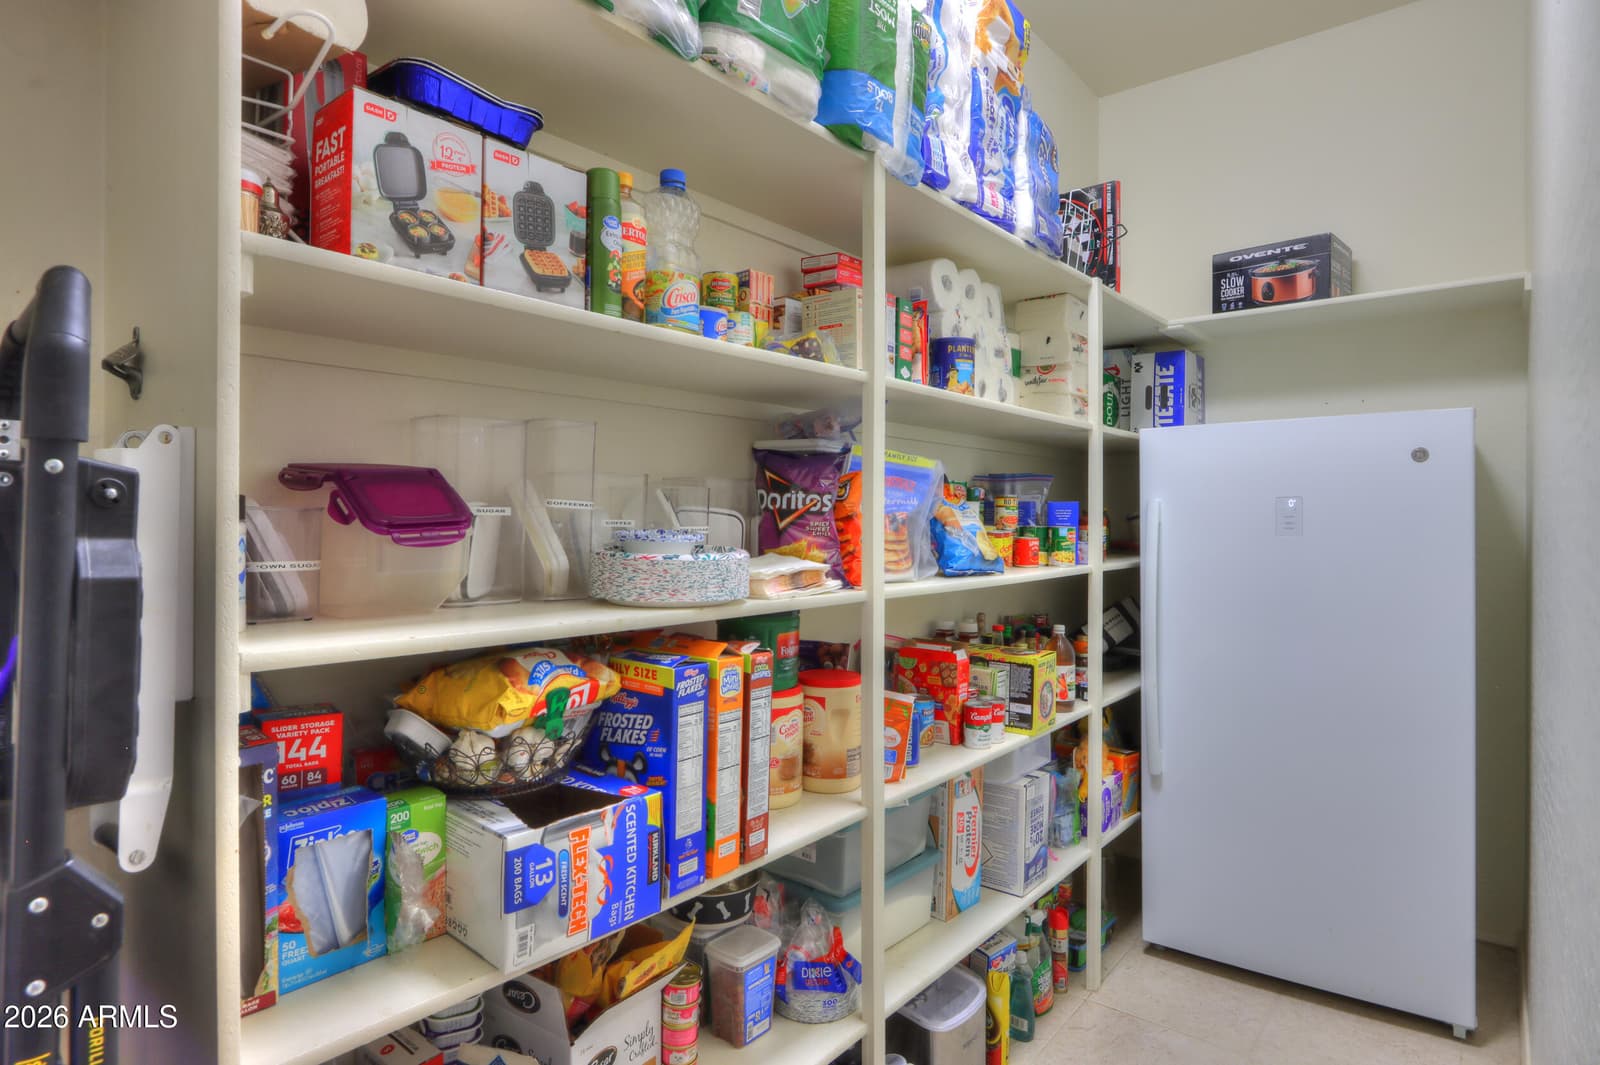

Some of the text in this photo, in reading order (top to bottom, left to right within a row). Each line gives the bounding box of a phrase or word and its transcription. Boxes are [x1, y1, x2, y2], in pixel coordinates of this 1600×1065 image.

[315, 125, 347, 163] FAST
[315, 151, 345, 177] PORTABLE
[441, 162, 467, 173] PROTEIN
[1229, 243, 1309, 263] OVENTE
[1220, 276, 1245, 290] SLOW
[1220, 286, 1245, 298] COOKER
[668, 287, 697, 308] Crisco
[1121, 378, 1131, 417] LIGHT
[757, 489, 834, 513] Doritos
[533, 661, 551, 679] SIZE
[633, 666, 658, 681] SIZE
[676, 674, 705, 691] FROSTED
[678, 682, 703, 698] FLAKES
[271, 720, 335, 733] SLIDER STORAGE
[598, 712, 653, 729] FROSTED
[276, 727, 331, 739] VARIETY PACK
[600, 728, 648, 745] FLAKES
[277, 735, 327, 764] 144
[281, 770, 322, 785] 60 84
[284, 798, 352, 818] Ziploc
[390, 810, 410, 825] 200
[964, 810, 973, 859] Protein
[970, 805, 979, 858] Premier
[623, 803, 637, 921] SCENTED KITCHEN
[651, 832, 660, 881] KIRKLAND
[513, 857, 522, 905] 200 BAGS
[534, 857, 554, 887] 13
[567, 824, 592, 938] FLEX-TECH
[609, 902, 619, 928] Bags
[281, 940, 297, 952] 50
[281, 946, 309, 960] FREE
[281, 954, 306, 967] QUART
[623, 1023, 655, 1051] Simply
